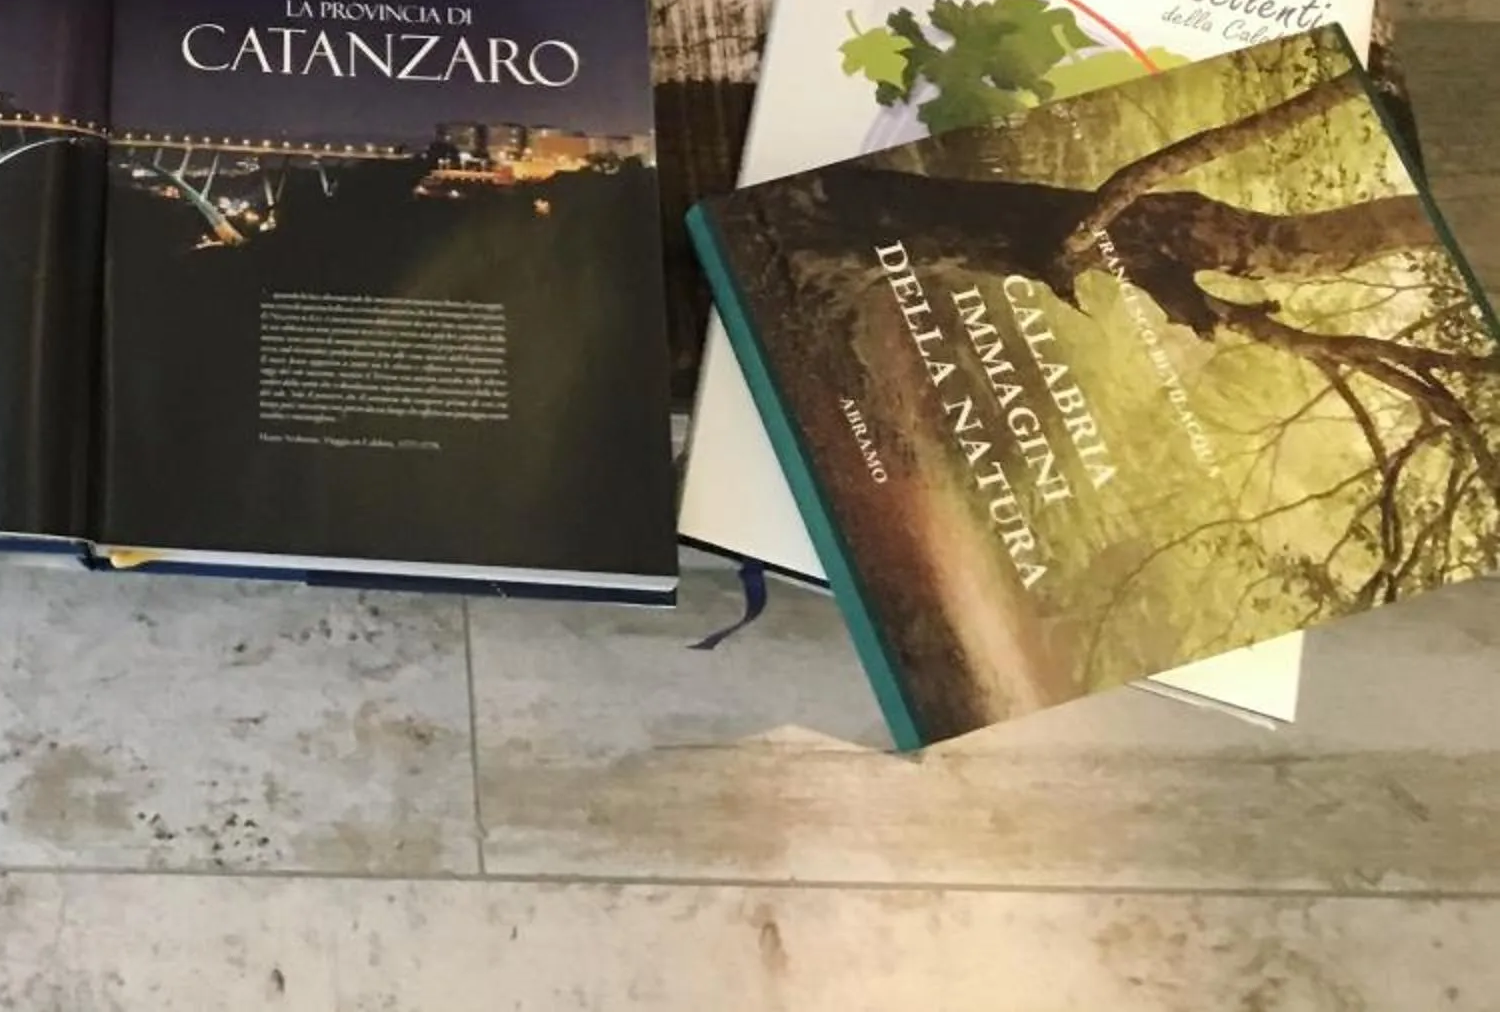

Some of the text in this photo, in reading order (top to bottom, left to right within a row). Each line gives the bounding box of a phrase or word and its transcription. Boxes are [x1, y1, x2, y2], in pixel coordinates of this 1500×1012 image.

[181, 23, 580, 88] CATANZARO
[286, 0, 473, 25] LA PROVINCIA DI
[1161, 4, 1214, 33] della
[874, 240, 1049, 590] DELLA NATURA
[950, 284, 1075, 505] IMMAGINI
[1003, 275, 1119, 490] CALABRIA
[840, 398, 889, 485] ABRAMO
